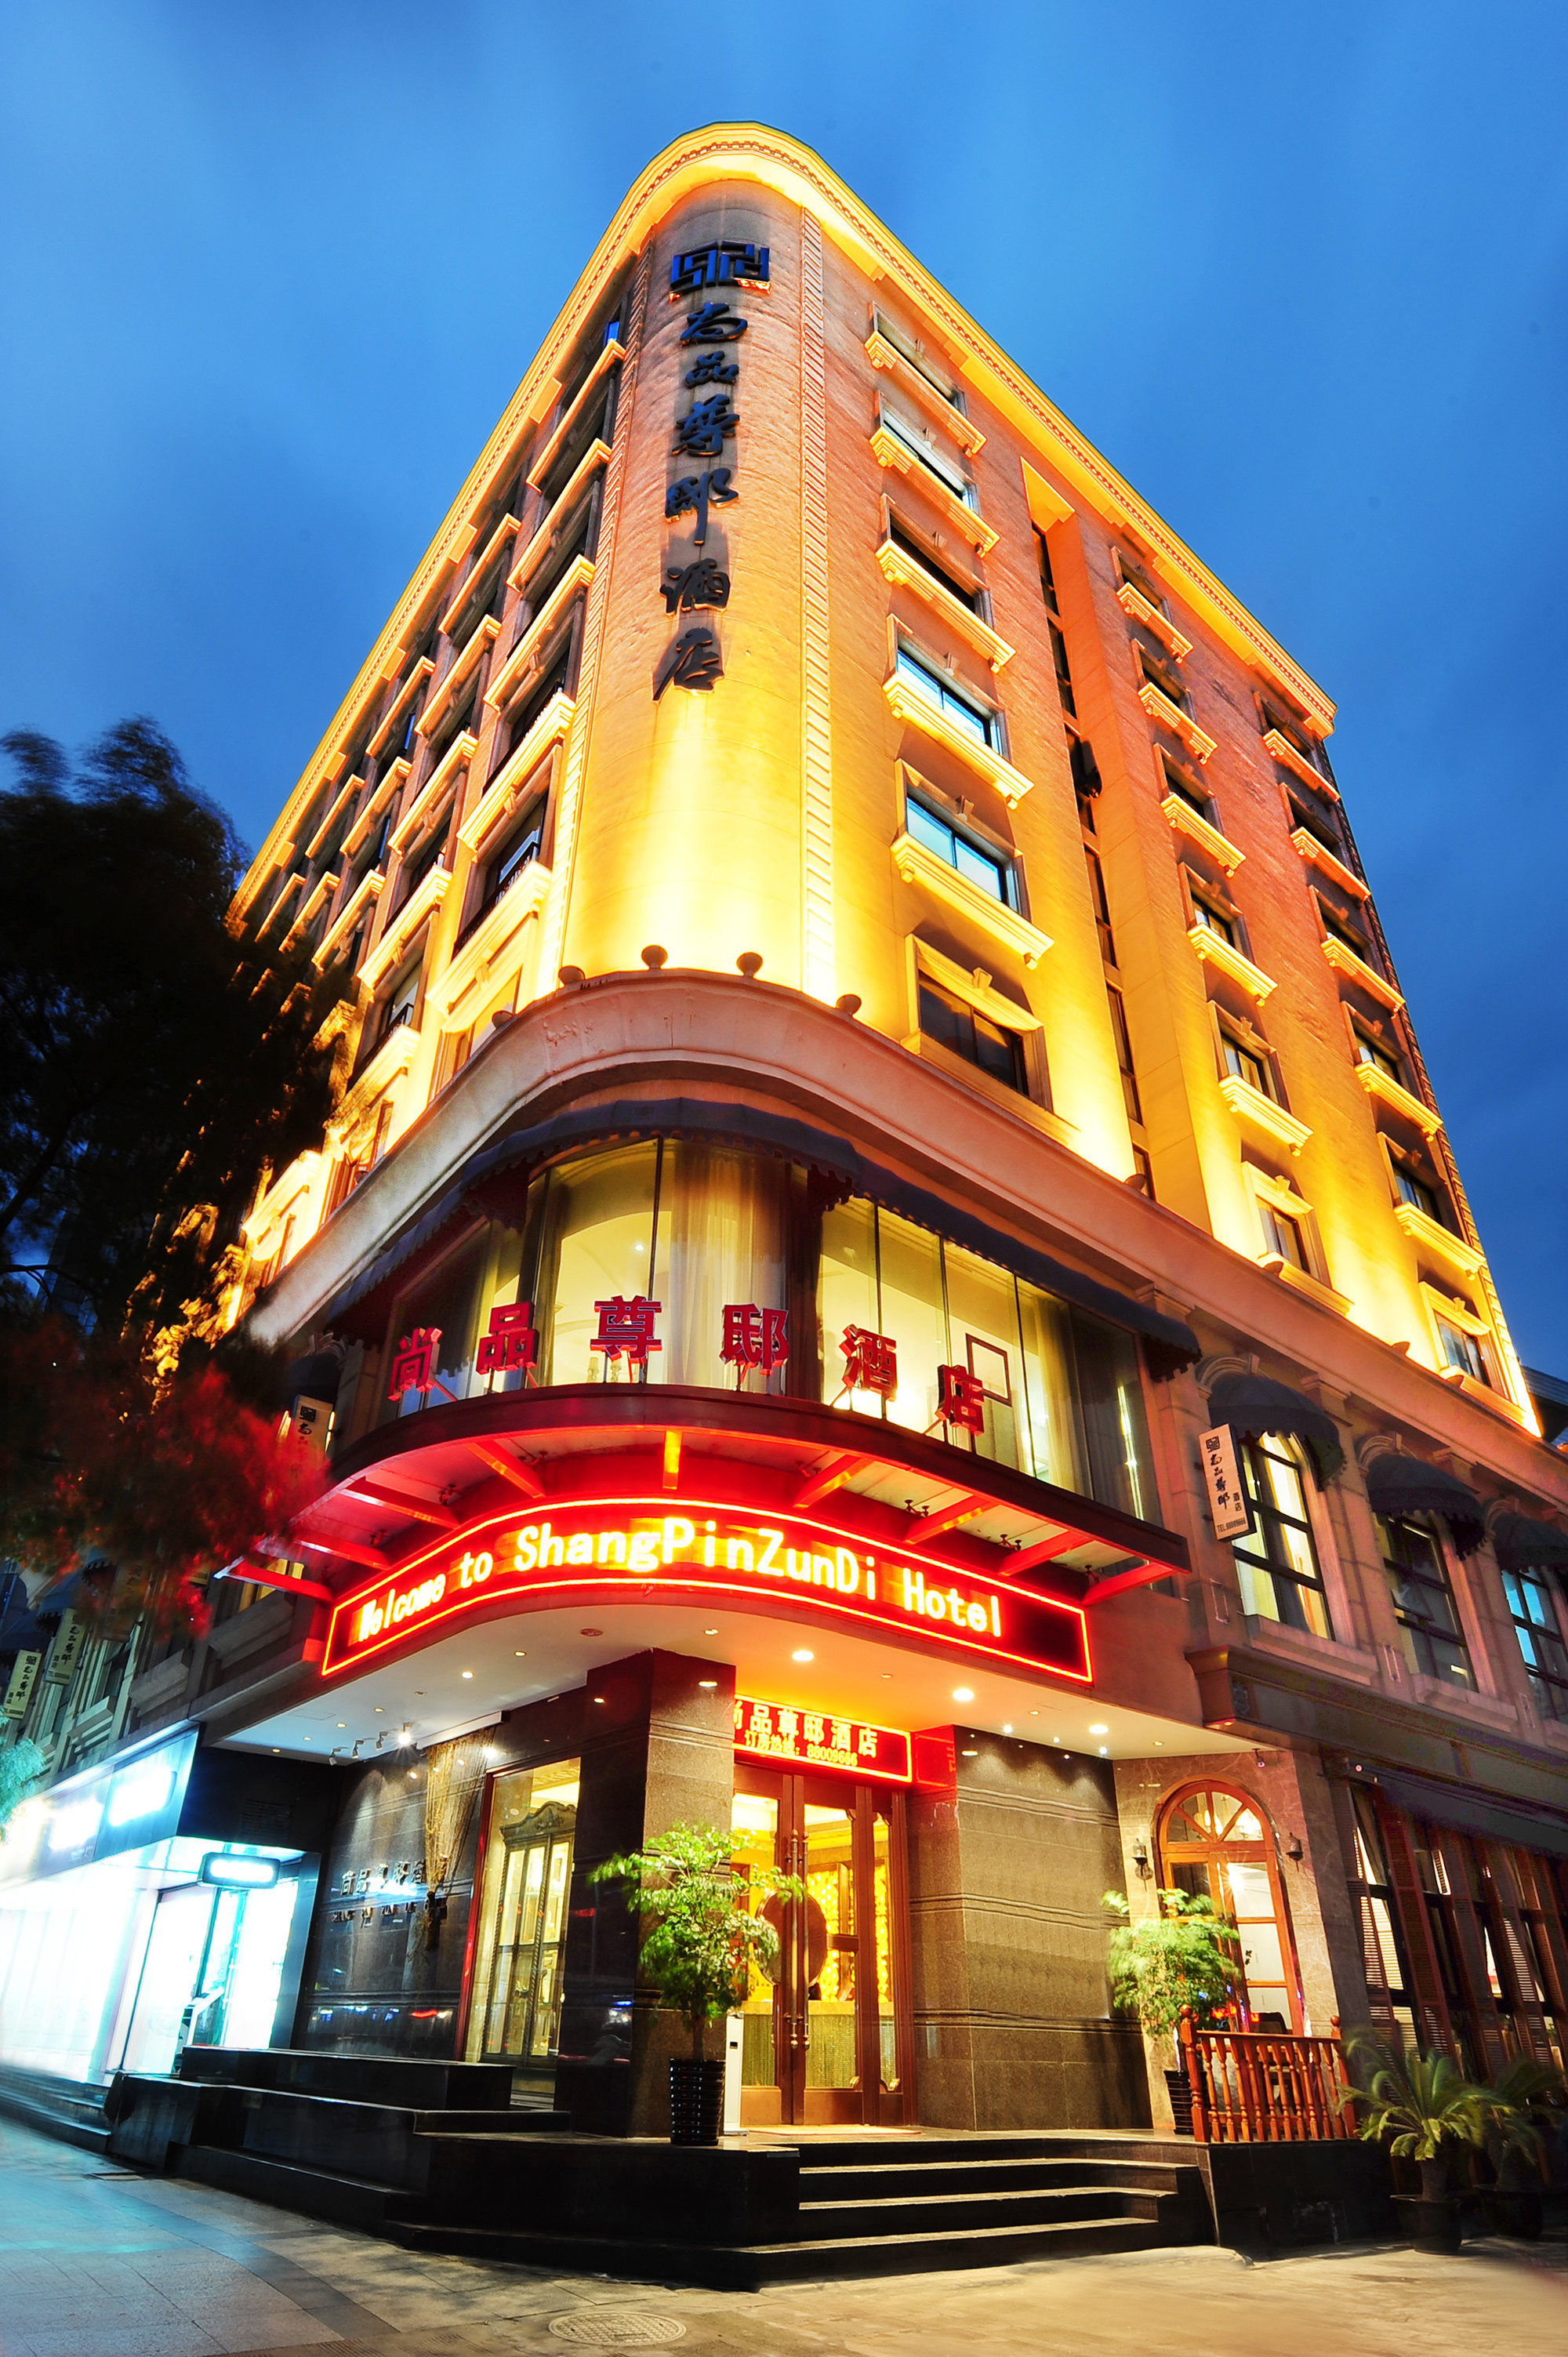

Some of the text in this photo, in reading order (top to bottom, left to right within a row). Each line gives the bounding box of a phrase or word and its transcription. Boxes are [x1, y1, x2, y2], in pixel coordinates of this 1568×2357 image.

[652, 302, 748, 703] 尚品尊邸酒店
[387, 1295, 985, 1436] 尚品尊邸酒店
[358, 1518, 1001, 1642] Welcome to ShangPinZunDi Hotel
